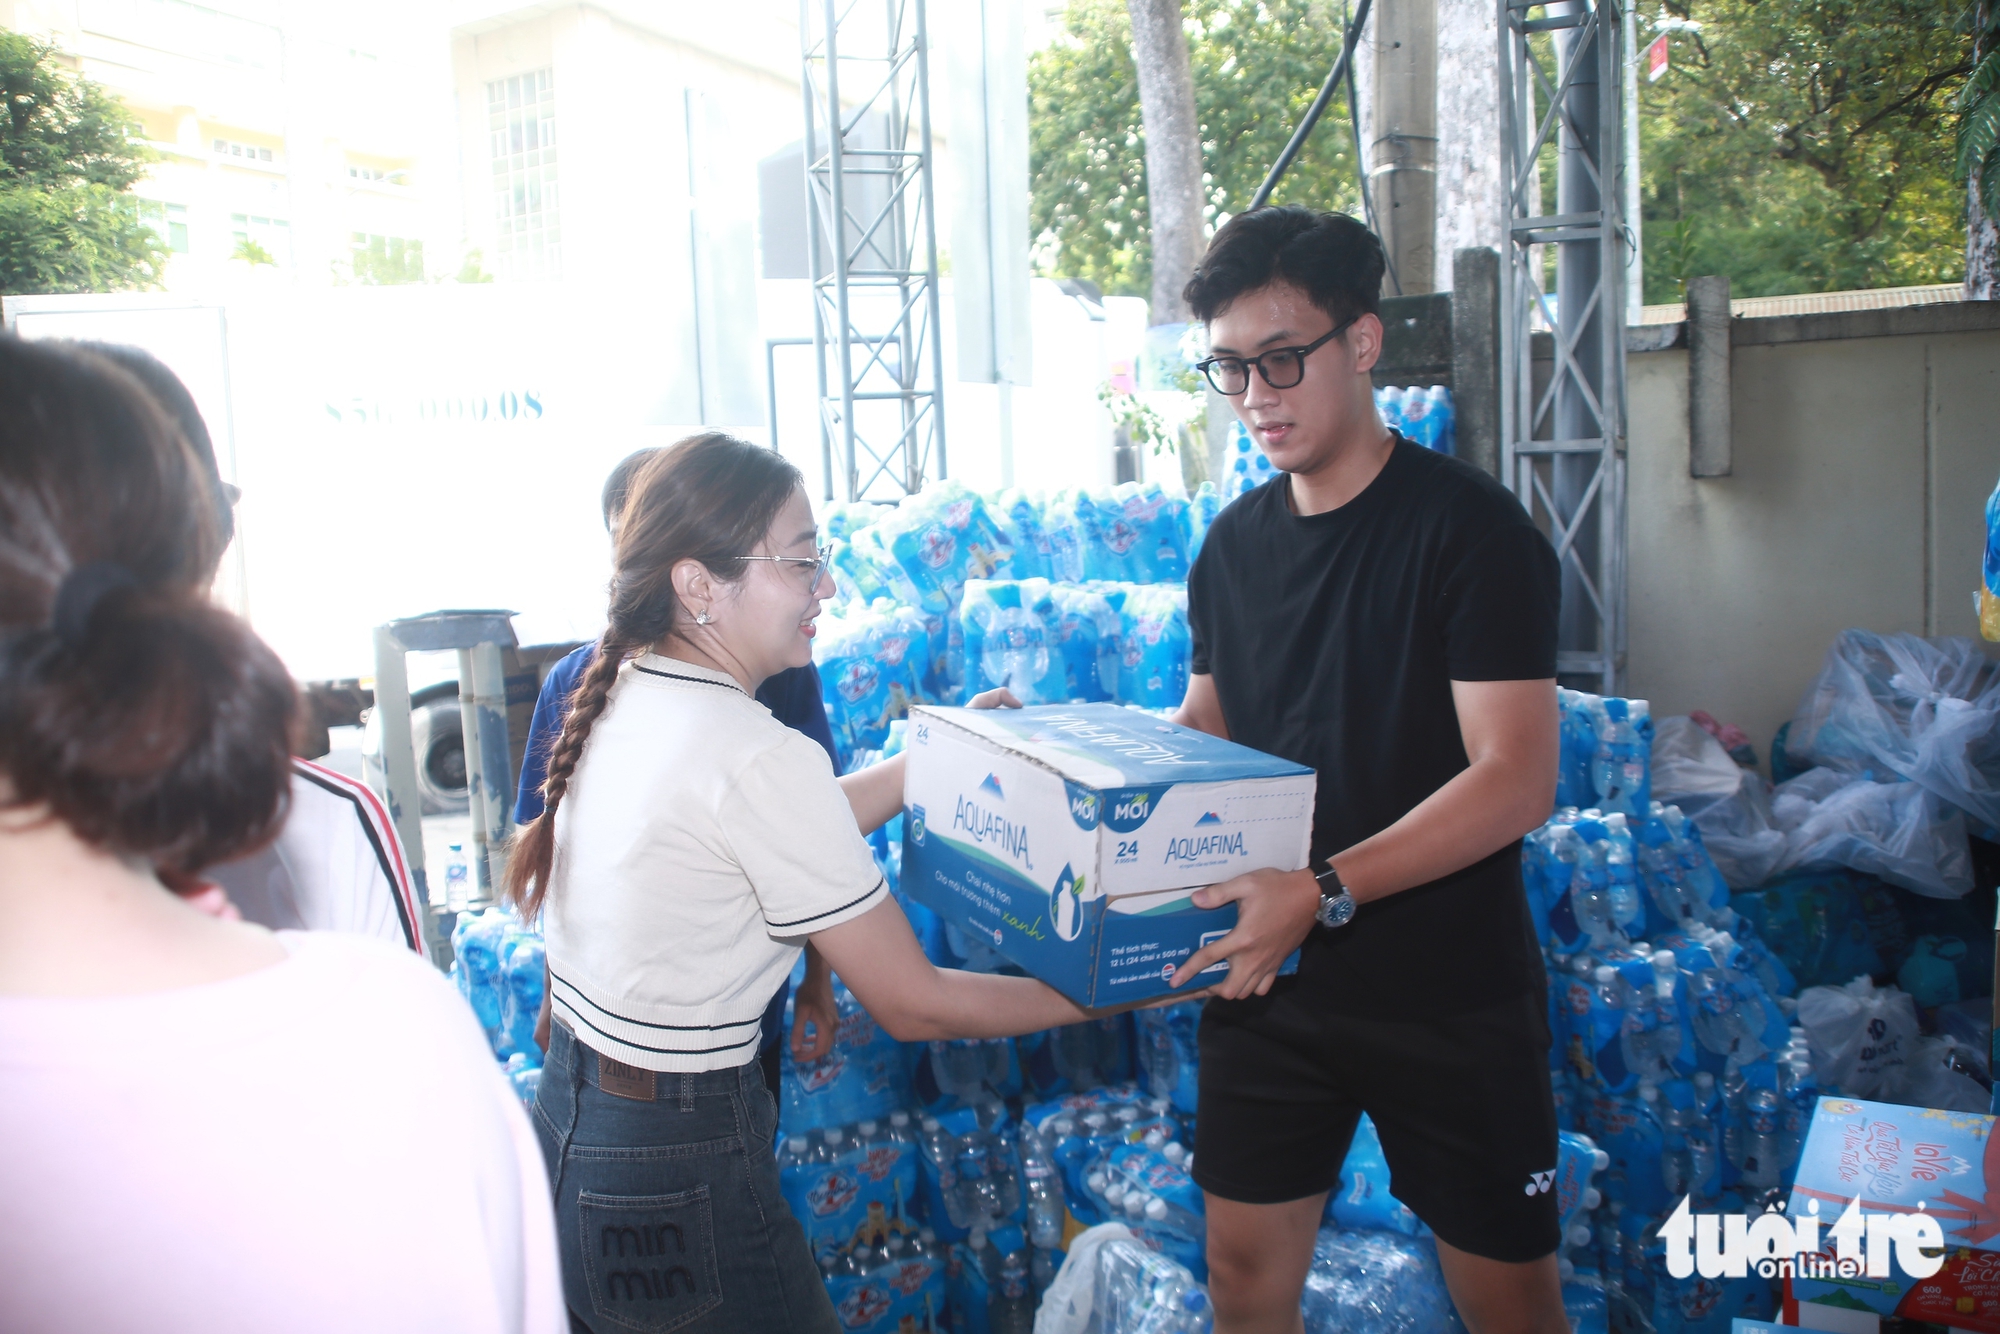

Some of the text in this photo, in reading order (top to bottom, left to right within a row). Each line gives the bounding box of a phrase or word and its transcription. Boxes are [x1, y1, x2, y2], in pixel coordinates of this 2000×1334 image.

[917, 723, 929, 740] 24
[1030, 713, 1209, 765] AQUAFINA
[953, 794, 1031, 869] AQUAFINA
[1164, 831, 1245, 864] AQUAFINA
[1116, 840, 1139, 857] 24
[966, 870, 982, 888] Chai
[935, 870, 948, 885] Cho
[1002, 911, 1046, 941] xanh
[1110, 959, 1118, 968] 12
[1162, 949, 1177, 959] 500
[601, 1222, 686, 1258] min
[607, 1265, 696, 1301] min
[1922, 1286, 1942, 1294] 600
